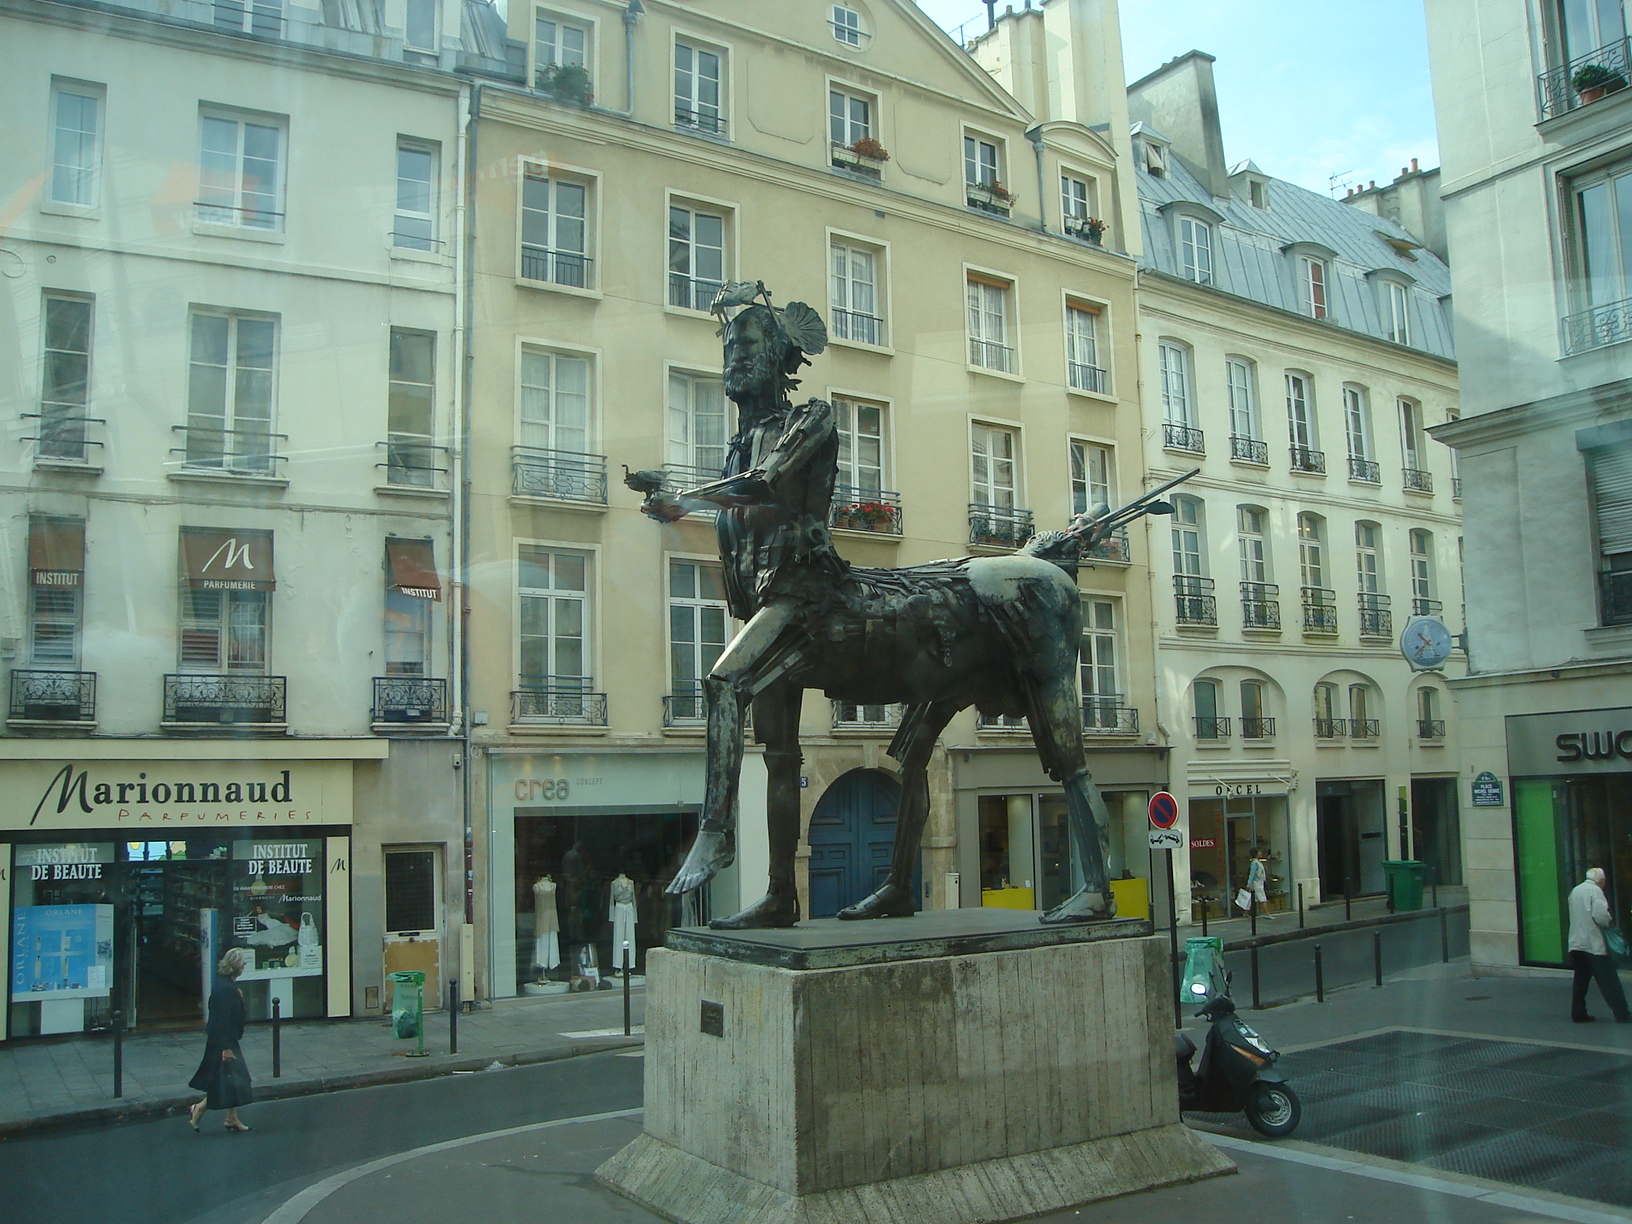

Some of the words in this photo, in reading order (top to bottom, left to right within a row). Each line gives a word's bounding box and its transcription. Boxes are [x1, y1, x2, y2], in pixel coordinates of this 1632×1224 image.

[202, 537, 255, 573] M
[36, 571, 79, 585] INSTITUT
[203, 580, 256, 590] PARFUMERIE
[401, 586, 437, 599] INSTITUT
[515, 778, 570, 801] crea
[576, 777, 603, 786] CONCEPT
[801, 777, 807, 787] 5
[29, 763, 293, 826] Marionnaud
[118, 808, 312, 821] PARFUMERIES
[252, 843, 308, 859] INSTITUT
[1191, 840, 1215, 849] SOLDES
[36, 848, 98, 864] INSTITUT
[31, 865, 49, 881] DE
[53, 864, 102, 880] BEAUTE
[248, 860, 265, 875] DE
[268, 859, 312, 874] BEAUTE
[278, 894, 322, 904] Marionnaud
[45, 909, 83, 917] ORLANE
[16, 911, 26, 985] ORLANE
